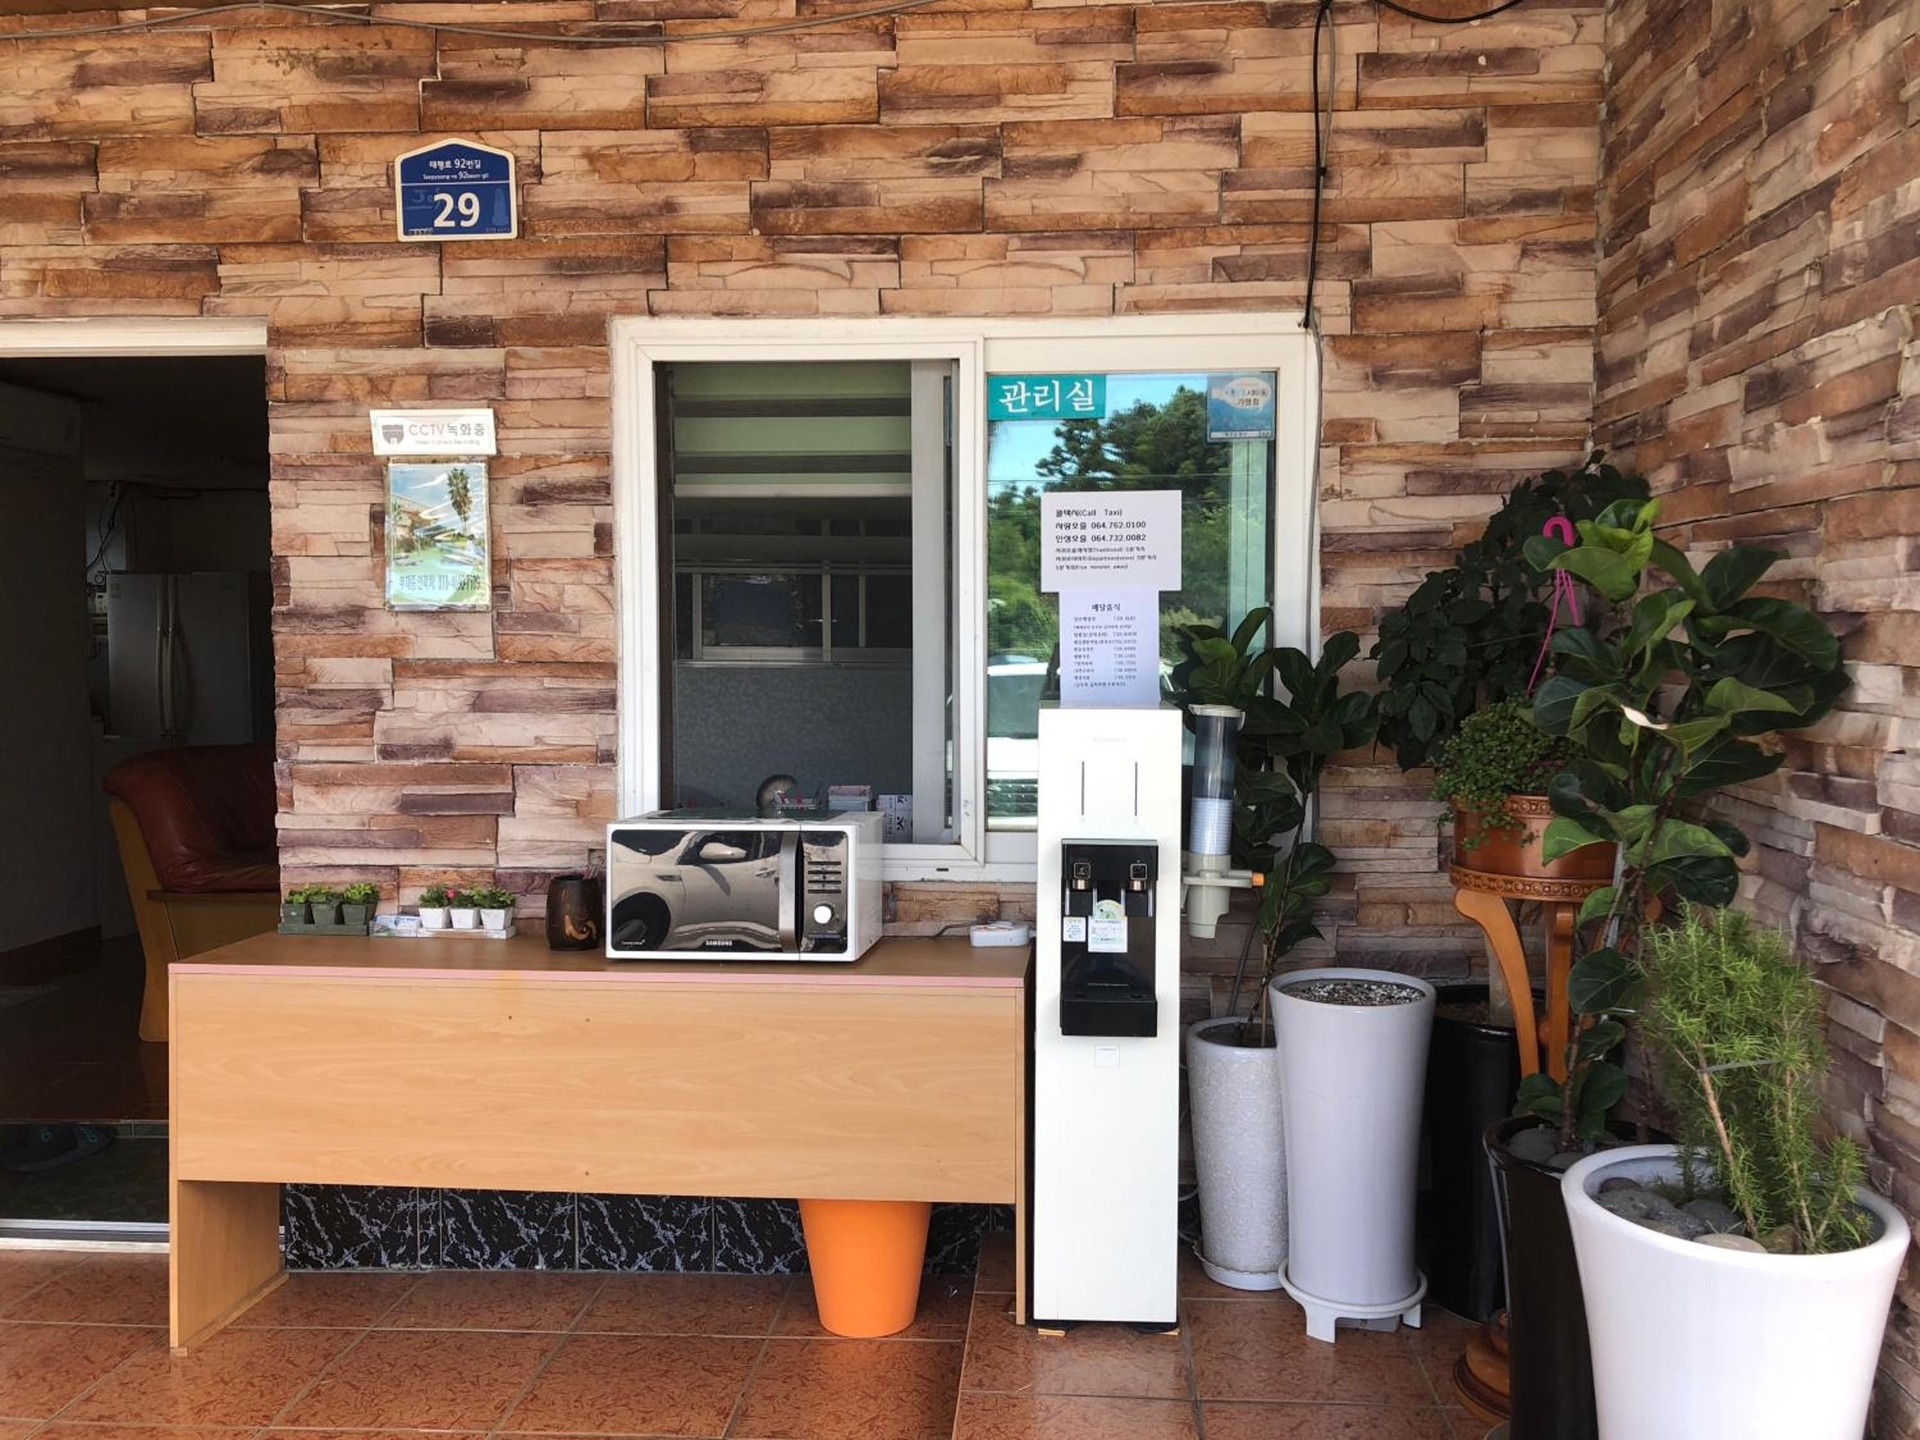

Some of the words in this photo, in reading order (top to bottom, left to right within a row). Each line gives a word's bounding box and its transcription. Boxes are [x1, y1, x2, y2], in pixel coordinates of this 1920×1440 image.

[433, 192, 480, 228] 29
[998, 378, 1095, 413] 관리실
[1091, 520, 1146, 530] 064.762.0100
[1091, 534, 1146, 543] 064.732.0082
[1091, 603, 1121, 612] 배달음식
